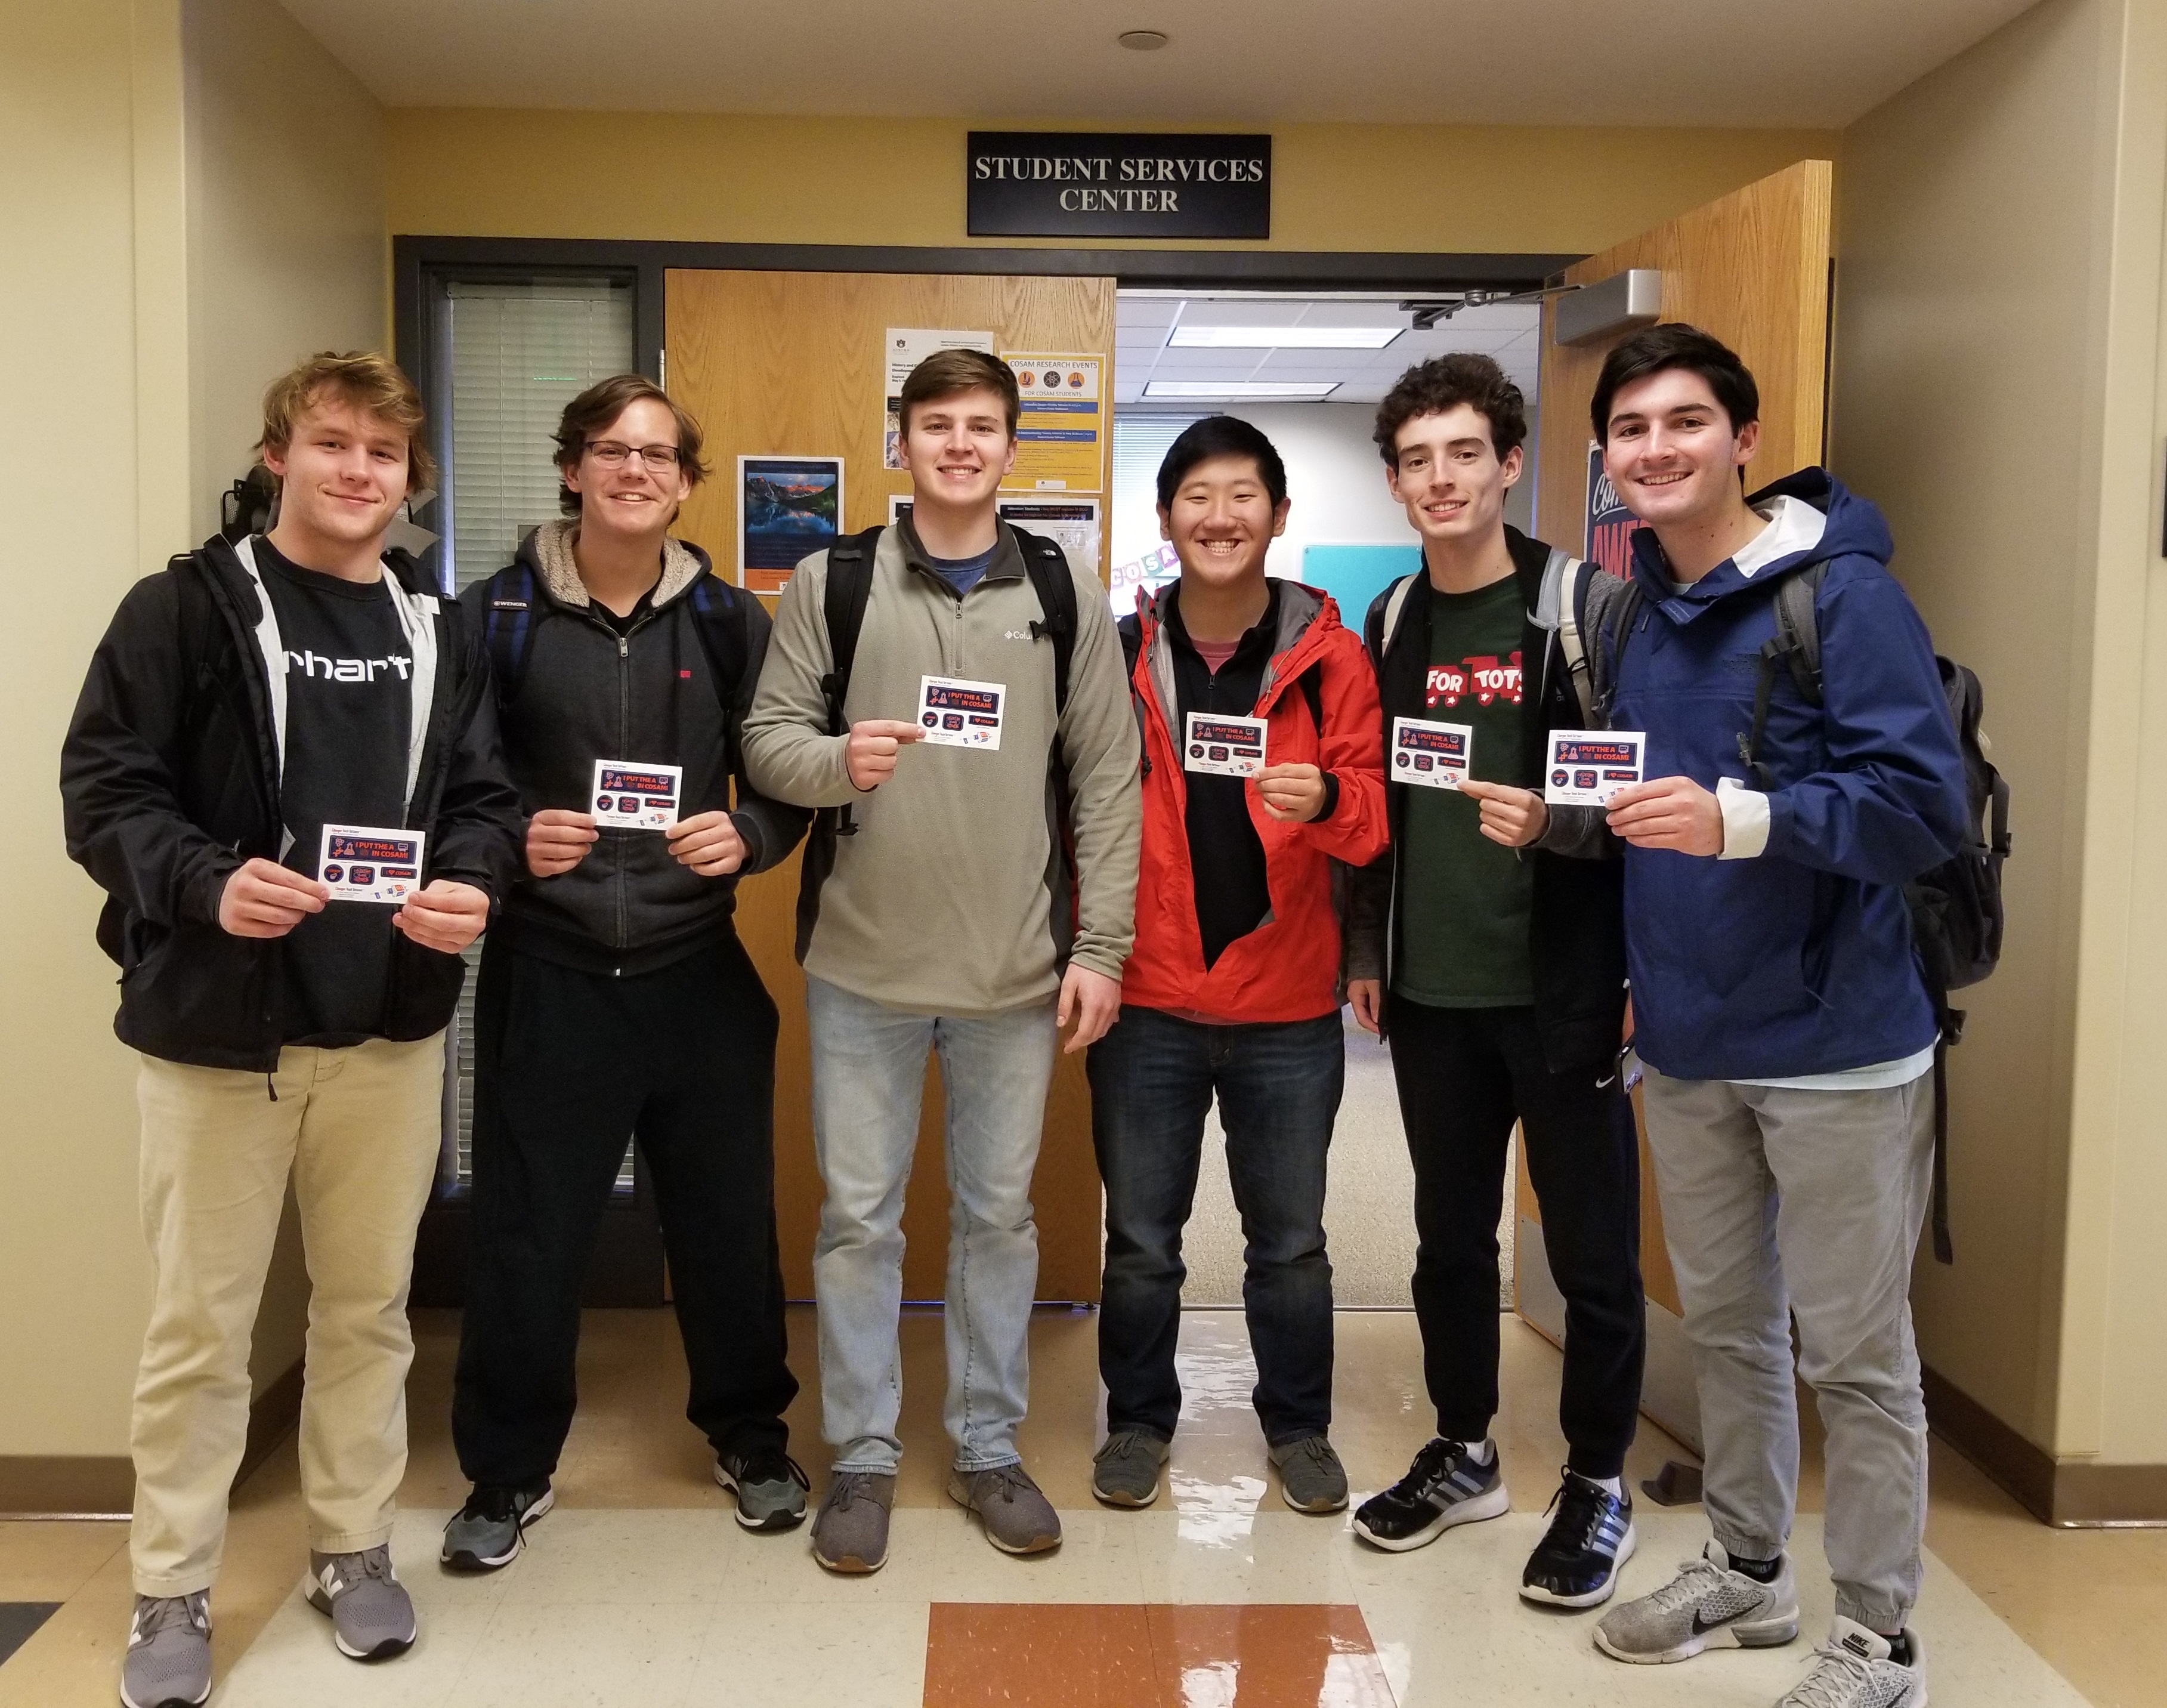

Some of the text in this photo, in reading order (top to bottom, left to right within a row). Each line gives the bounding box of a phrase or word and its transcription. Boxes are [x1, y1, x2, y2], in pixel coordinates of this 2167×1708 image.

[975, 157, 1263, 182] STUDENT SERVICES
[1060, 189, 1179, 212] CENTER
[1426, 669, 1463, 693] FOR
[1847, 1632, 1871, 1648] NIKE
